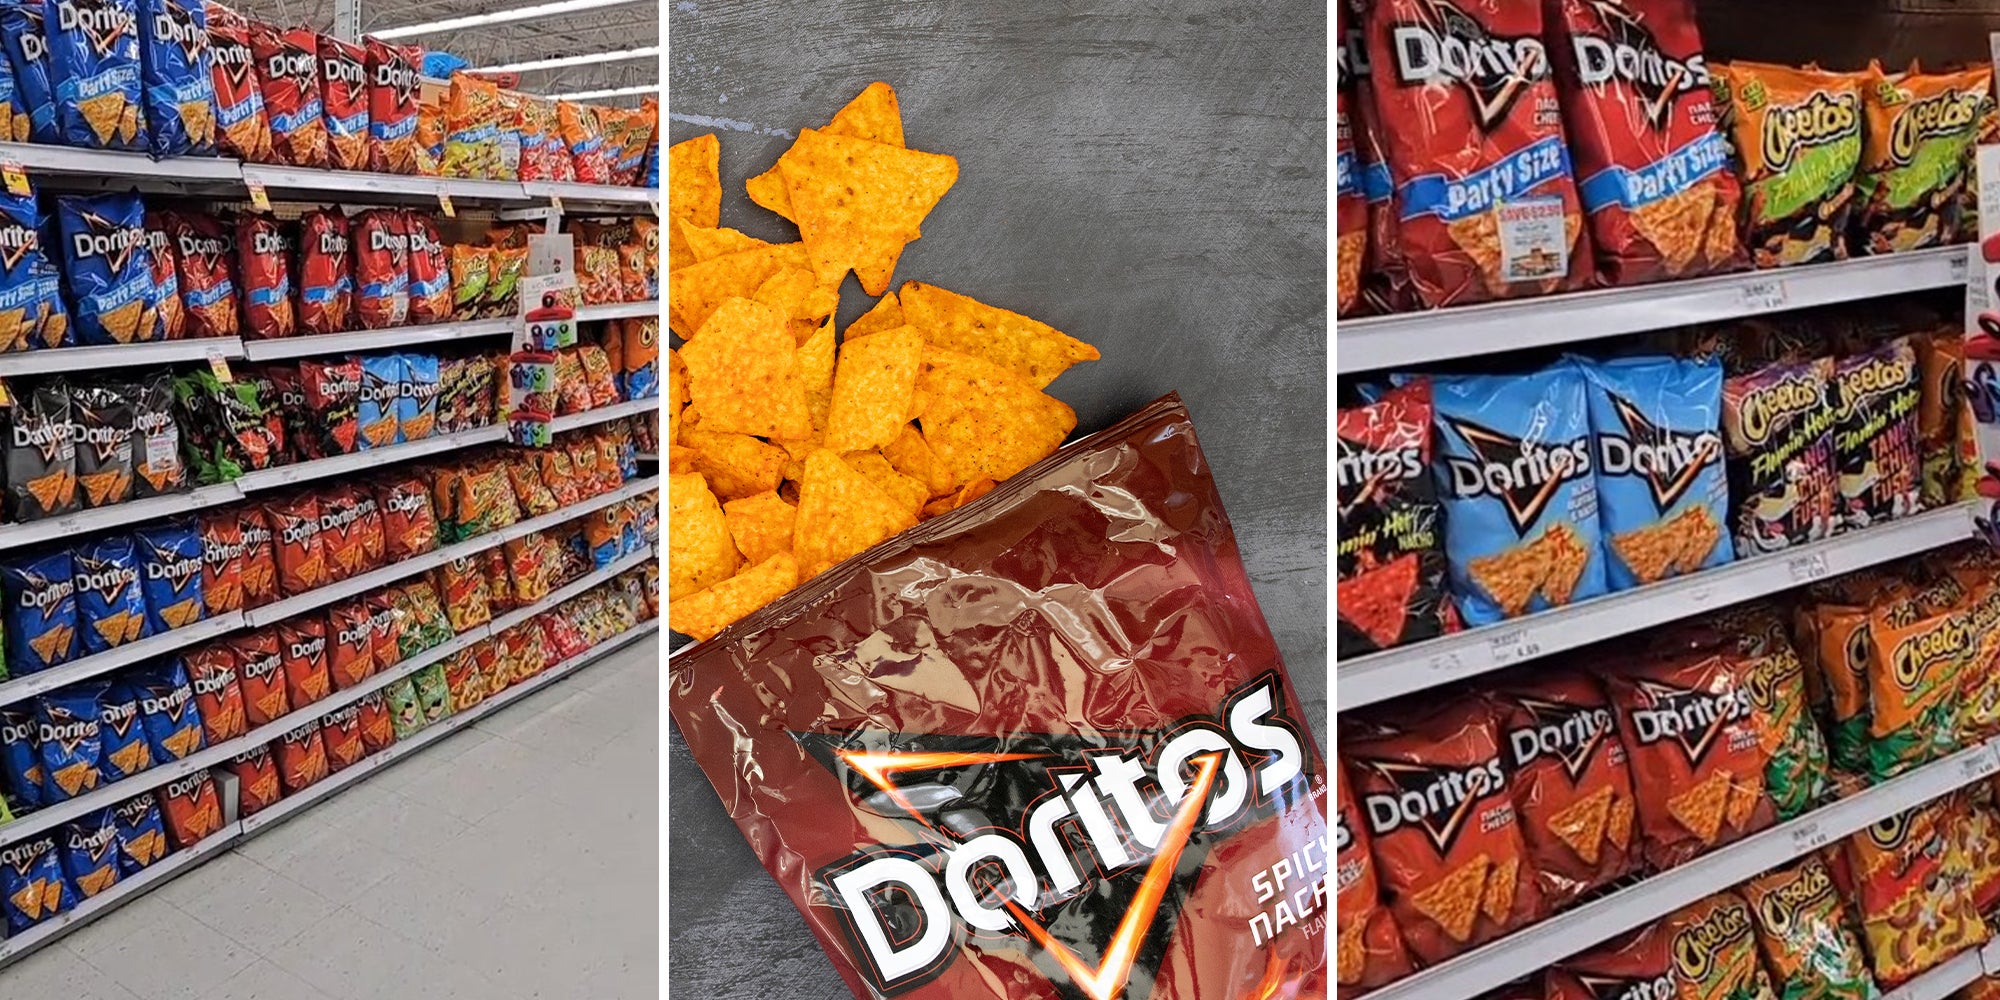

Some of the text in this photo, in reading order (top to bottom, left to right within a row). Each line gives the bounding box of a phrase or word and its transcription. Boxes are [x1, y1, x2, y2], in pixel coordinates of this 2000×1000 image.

[58, 1, 137, 36] Doritos
[1573, 36, 1711, 91] Doritos
[1764, 91, 1856, 168] Cheetos
[1448, 144, 1560, 214] Party Size
[1627, 154, 1688, 203] Party
[1742, 377, 1819, 442] Cheetos
[1453, 438, 1590, 495] Doritos
[77, 568, 138, 598] Doritos
[148, 557, 204, 585] Doritos
[1632, 688, 1751, 743] Doritos
[1366, 757, 1504, 832] Doritos
[833, 684, 1303, 982] Doritos
[1761, 863, 1831, 937] Cheetos
[1675, 907, 1751, 976] Cheetos
